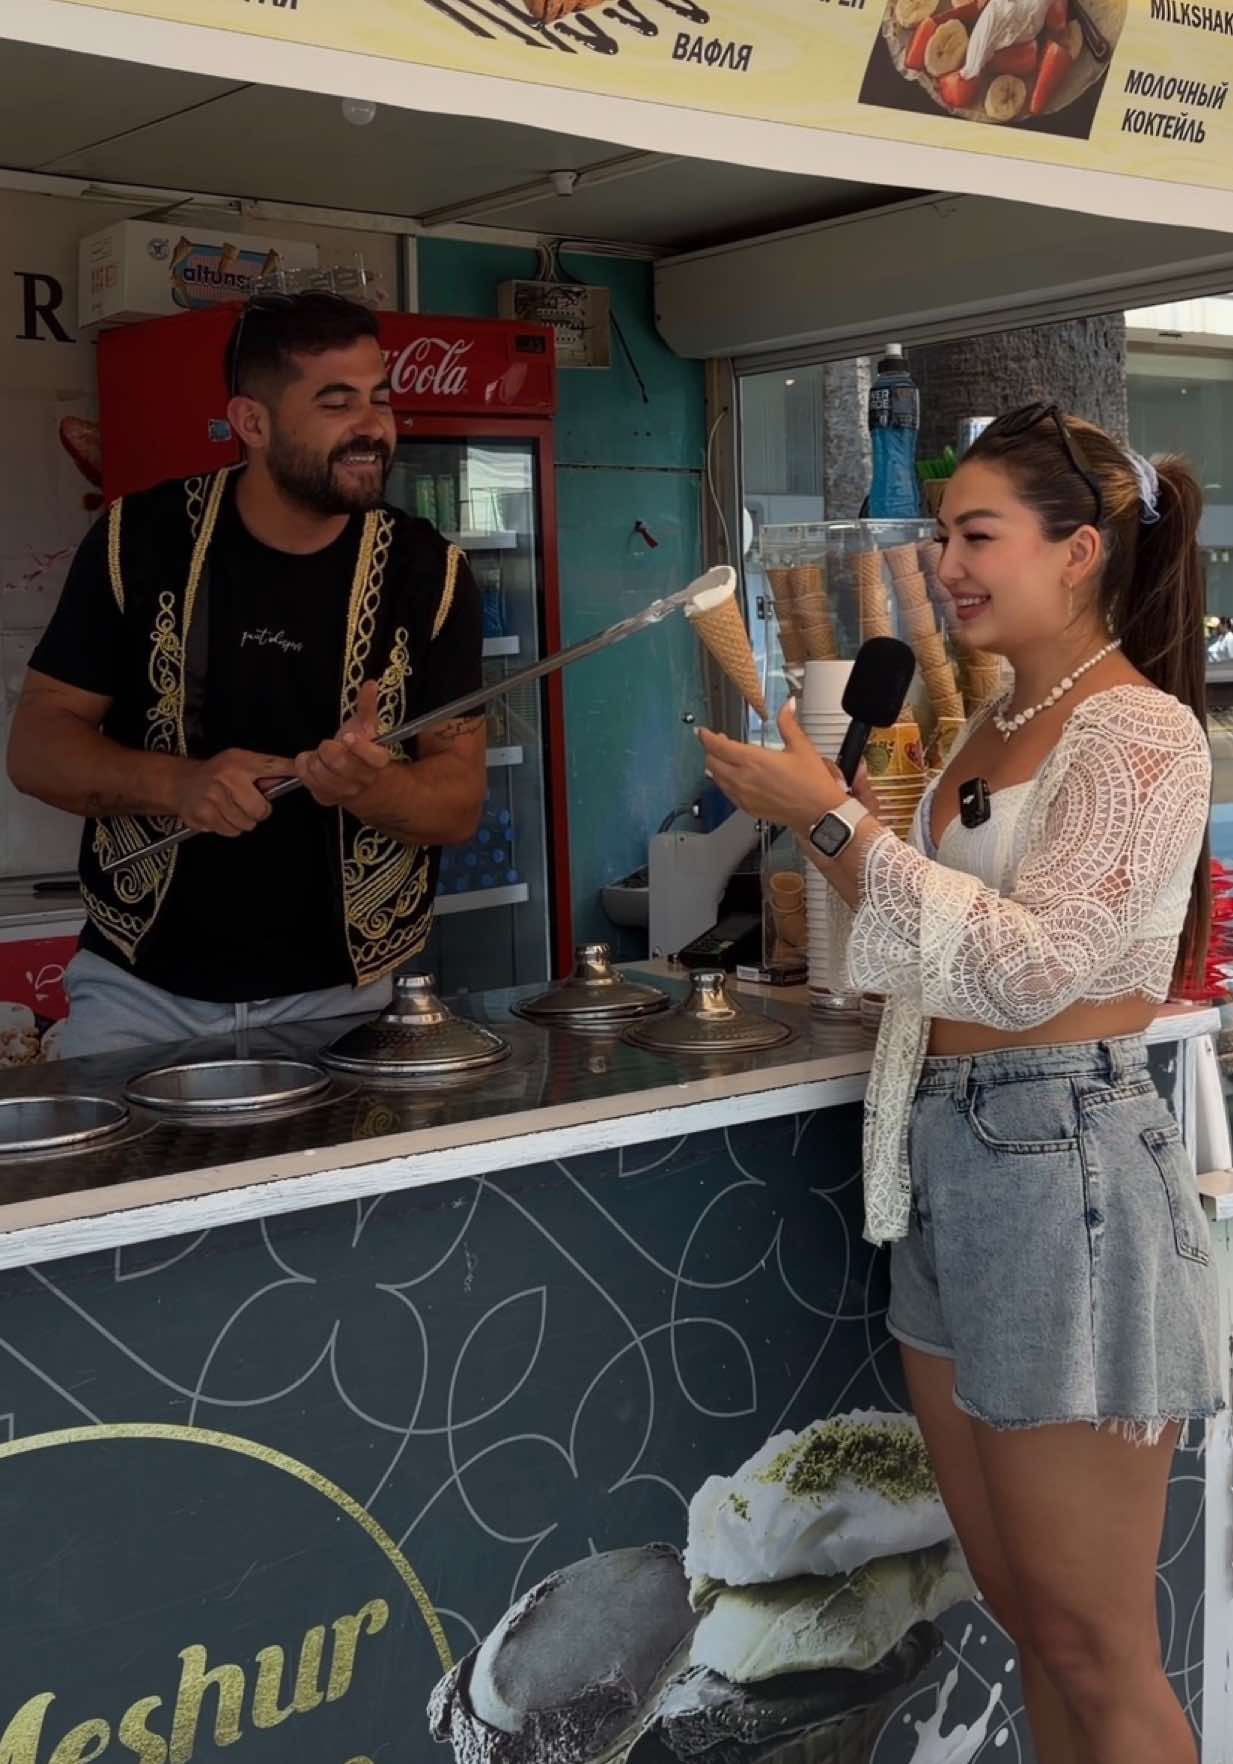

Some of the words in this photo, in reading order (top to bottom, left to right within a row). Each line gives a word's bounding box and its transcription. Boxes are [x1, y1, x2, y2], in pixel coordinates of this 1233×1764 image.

[672, 32, 753, 72] ВАФЛЯ
[1124, 69, 1229, 110] МОЛОЧНЫЙ
[1121, 108, 1206, 144] КОКТЕЙЛЬ
